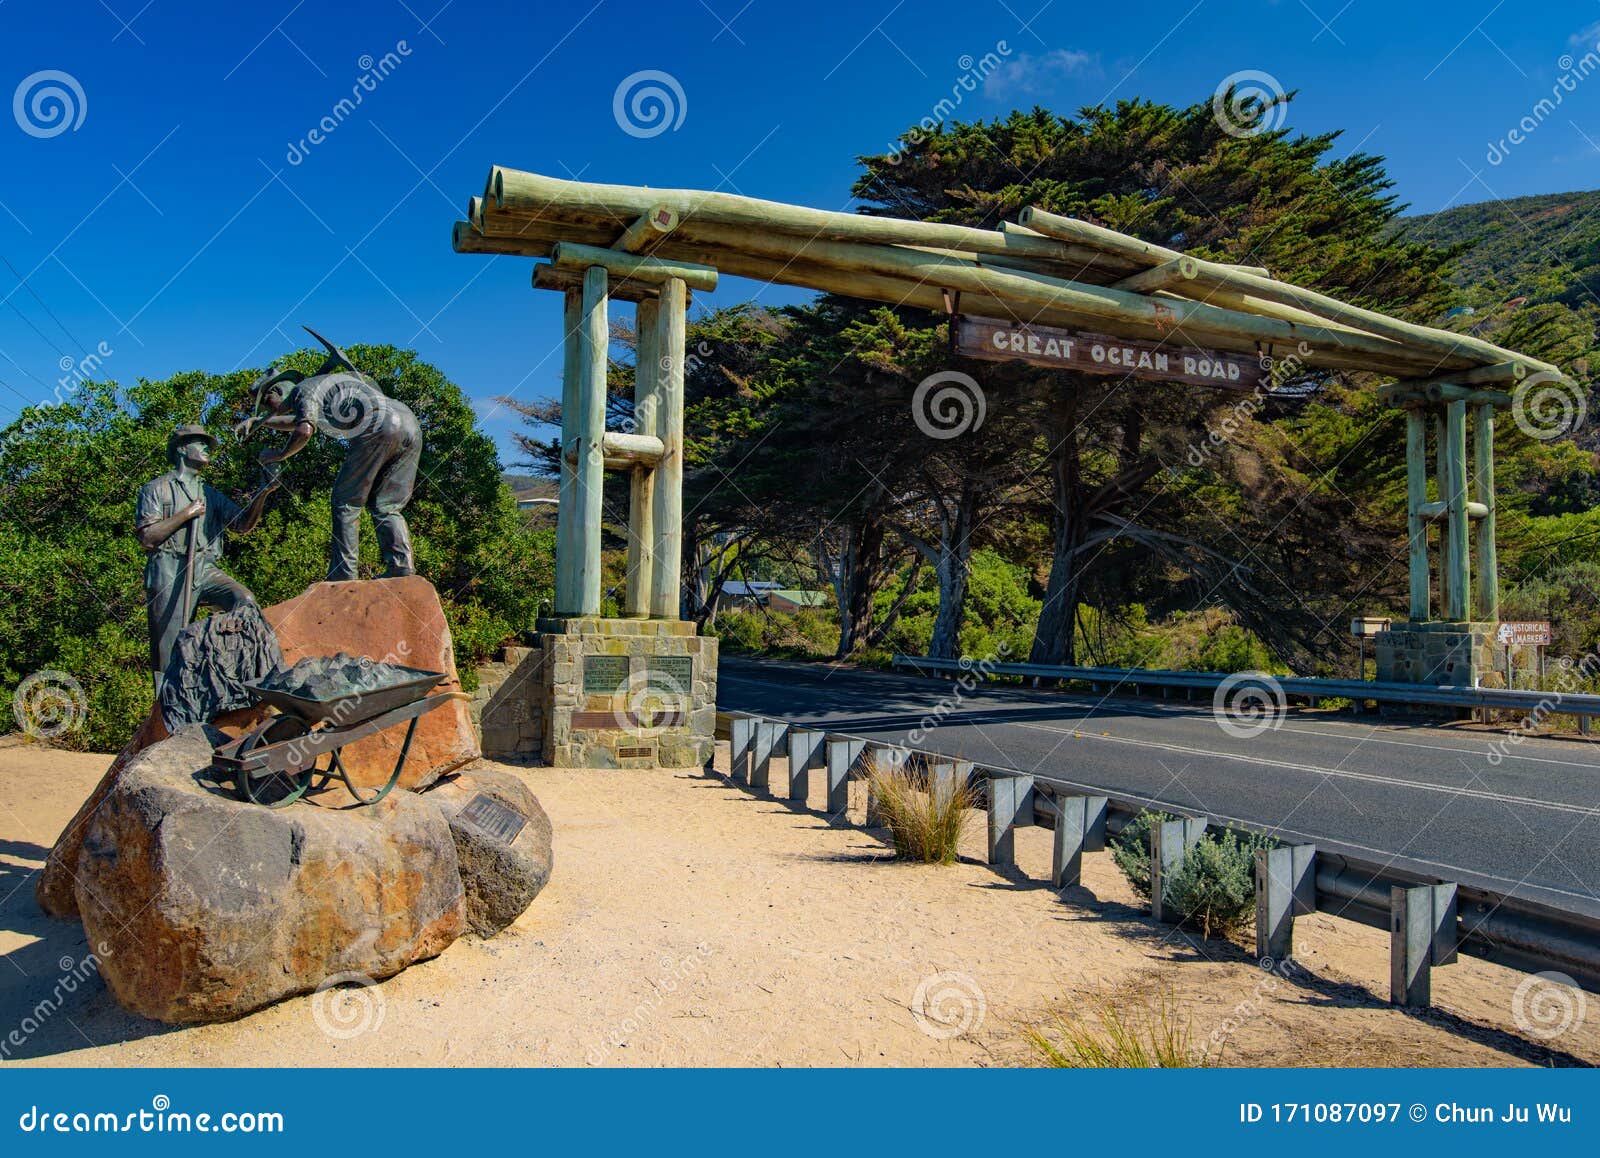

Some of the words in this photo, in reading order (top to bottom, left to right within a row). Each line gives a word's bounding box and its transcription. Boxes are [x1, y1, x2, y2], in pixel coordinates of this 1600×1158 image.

[992, 331, 1074, 359] GREAT
[1091, 344, 1169, 372] OCEAN
[1184, 356, 1240, 381] ROAD
[1511, 623, 1548, 633] HISTORICAL
